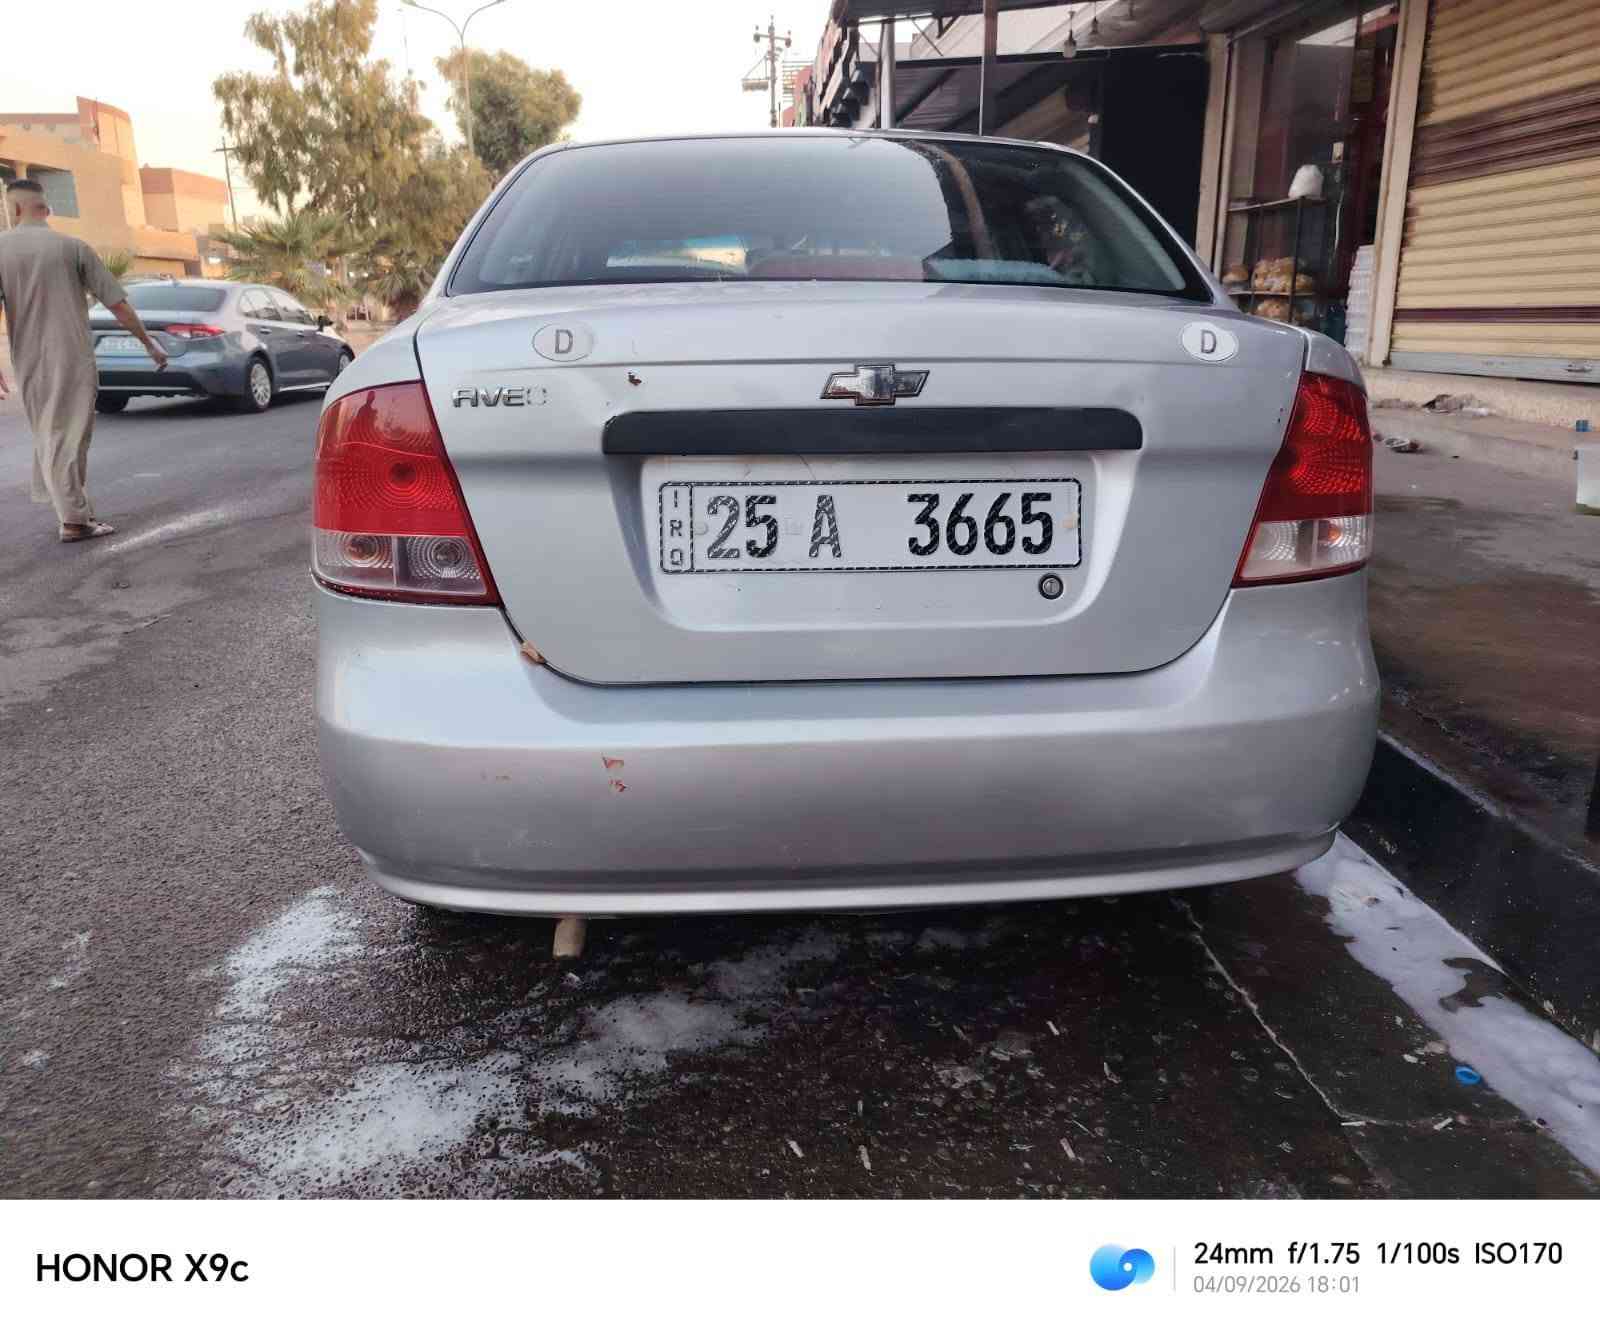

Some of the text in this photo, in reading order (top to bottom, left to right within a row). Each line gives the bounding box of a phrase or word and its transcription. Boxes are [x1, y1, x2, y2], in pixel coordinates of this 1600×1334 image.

[554, 329, 574, 354] D
[1200, 329, 1217, 354] D
[707, 492, 1054, 559] 25 A 3665
